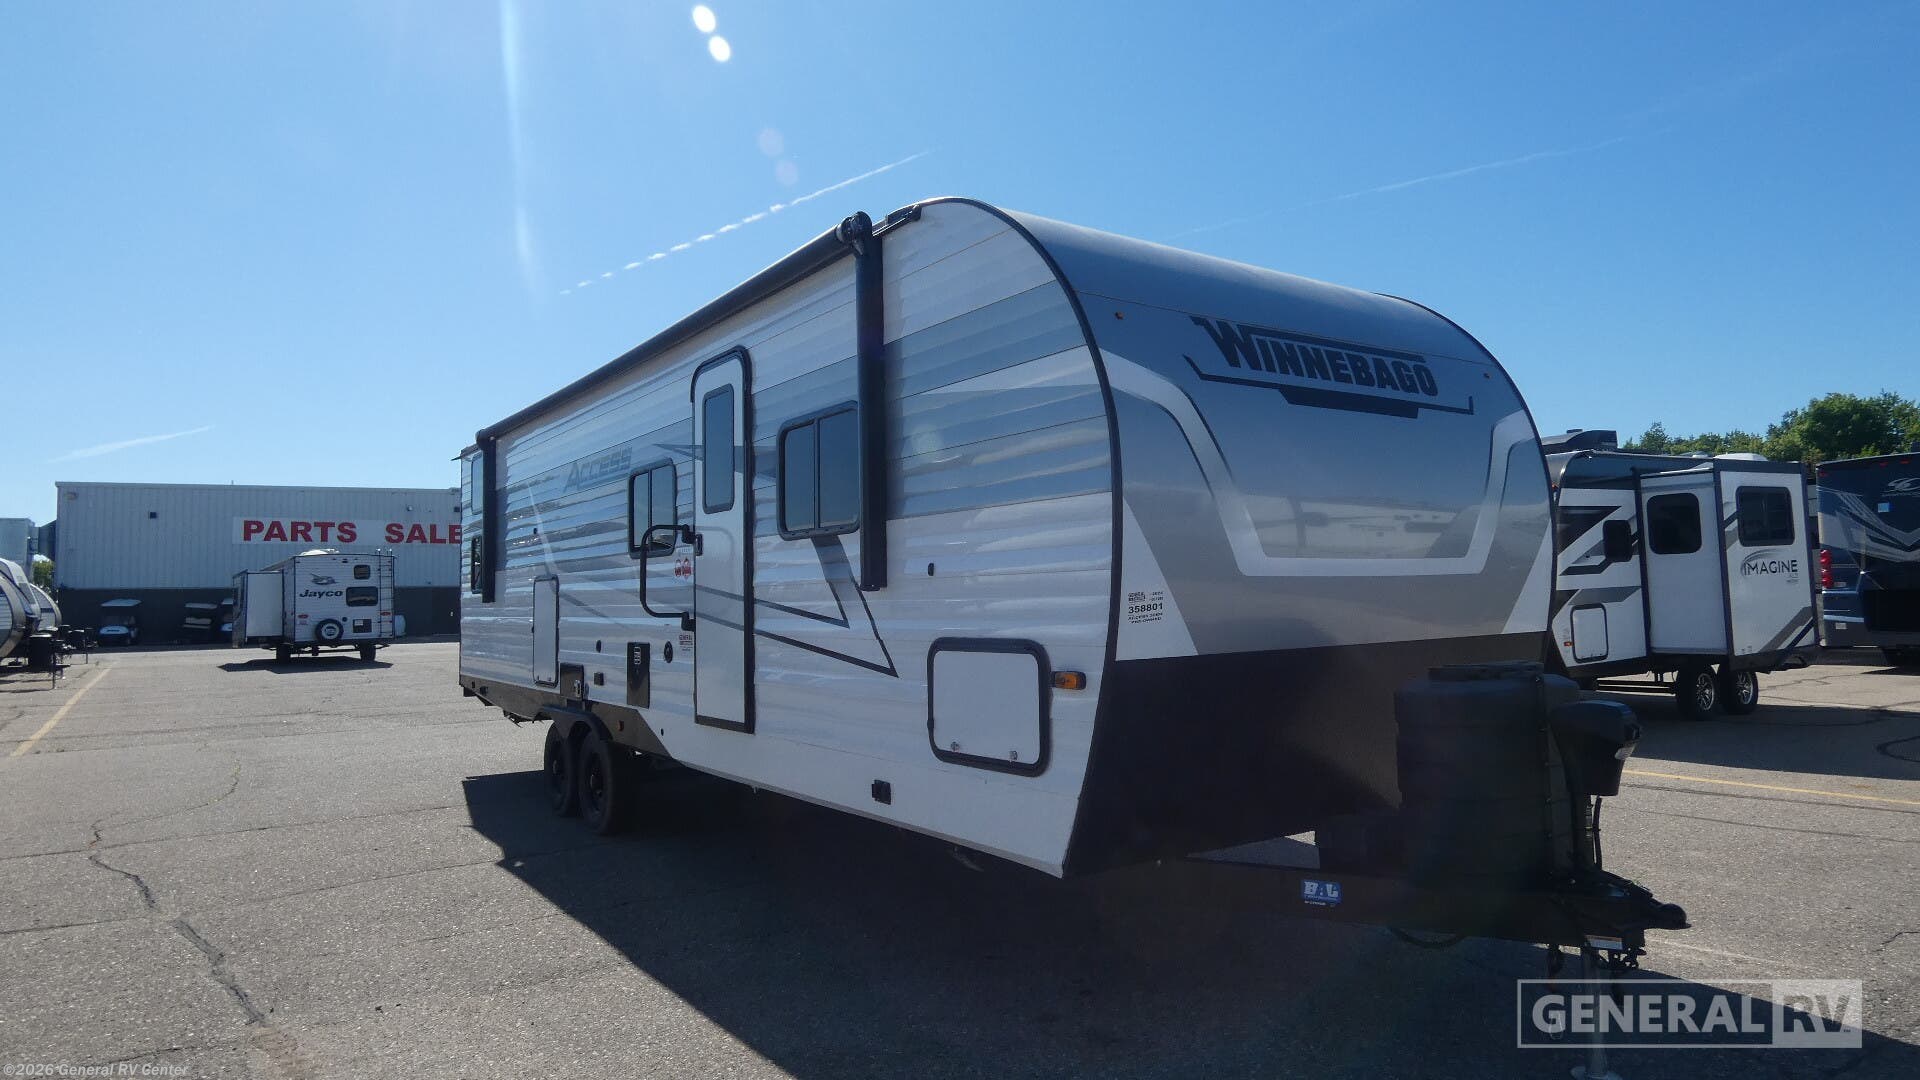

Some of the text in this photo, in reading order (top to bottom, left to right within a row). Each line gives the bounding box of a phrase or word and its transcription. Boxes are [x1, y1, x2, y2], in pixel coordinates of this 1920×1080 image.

[1189, 316, 1438, 396] WINNEBAGO
[563, 446, 632, 494] ACCESS
[243, 520, 357, 543] PARTS
[1744, 560, 1798, 575] IMAGINE
[300, 589, 343, 598] Jayco
[1128, 602, 1163, 613] 358801
